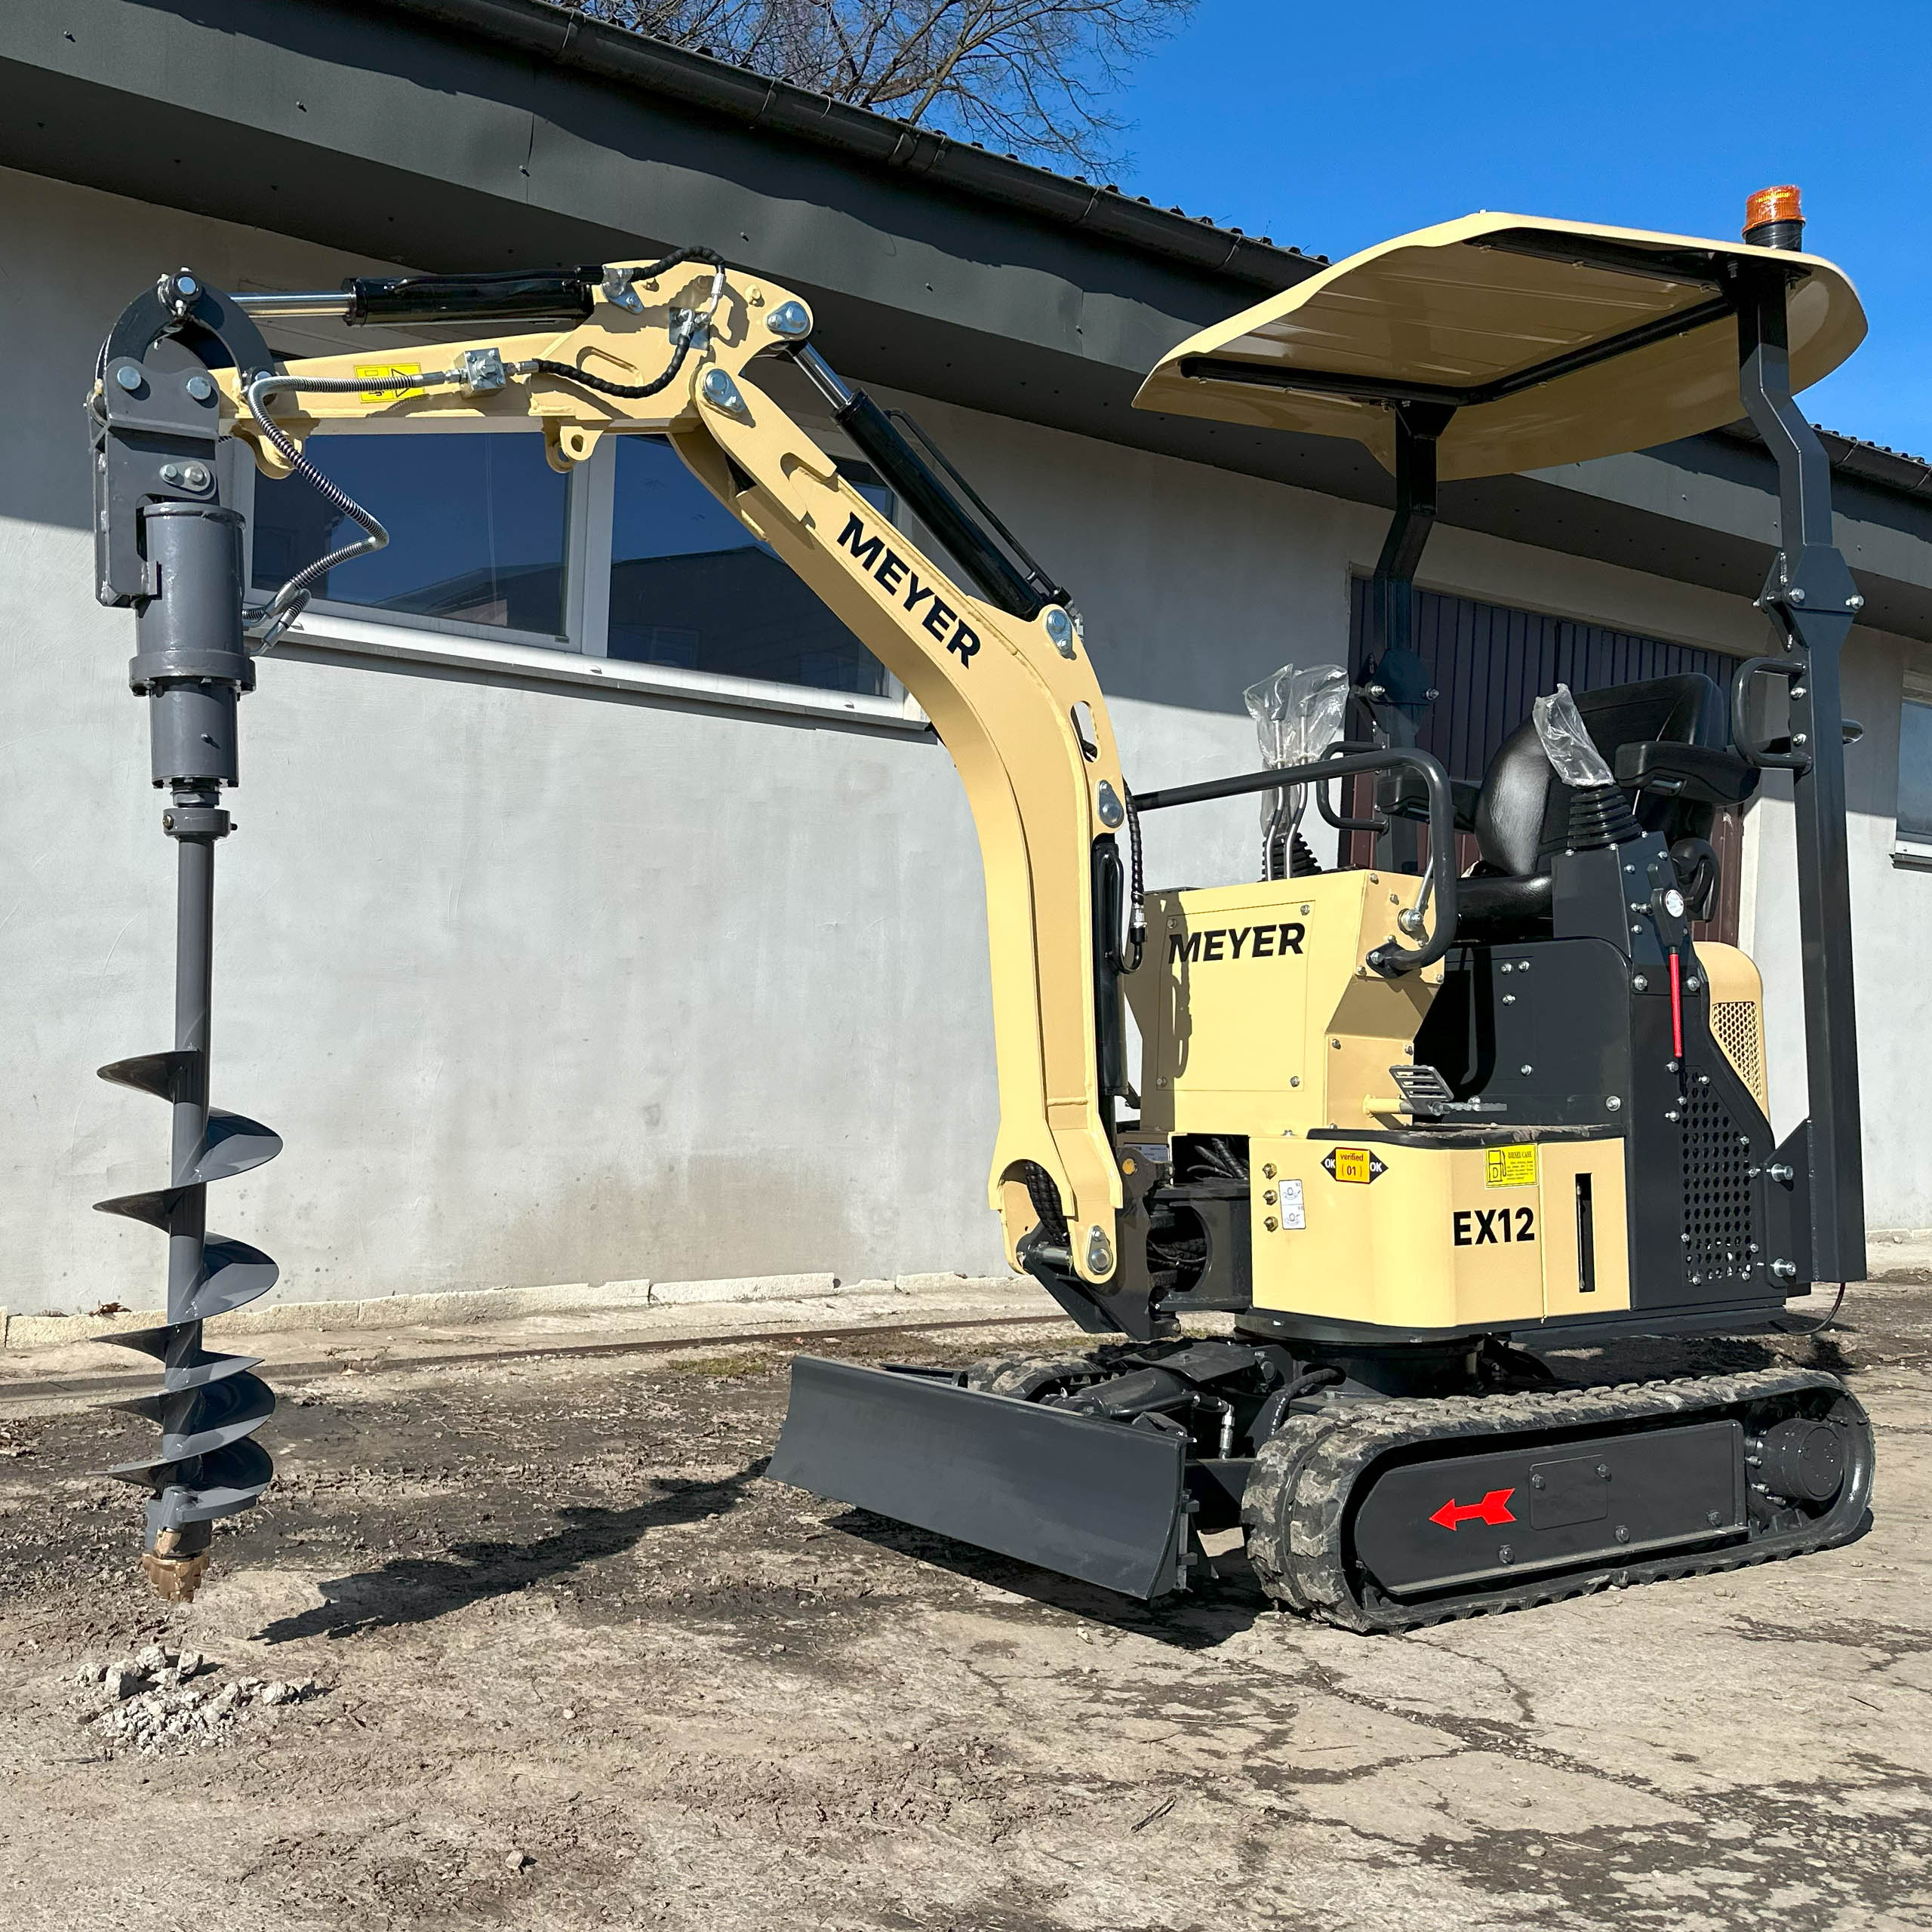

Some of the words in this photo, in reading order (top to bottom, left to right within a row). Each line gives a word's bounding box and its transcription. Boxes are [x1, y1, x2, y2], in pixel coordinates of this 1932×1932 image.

[837, 512, 981, 669] MEYER
[1168, 922, 1305, 964] MEYER
[1324, 1158, 1335, 1168] OK
[1340, 1153, 1363, 1161] verified
[1370, 1162, 1382, 1172] OK
[1493, 1167, 1498, 1179] D
[1453, 1207, 1535, 1246] EX12
